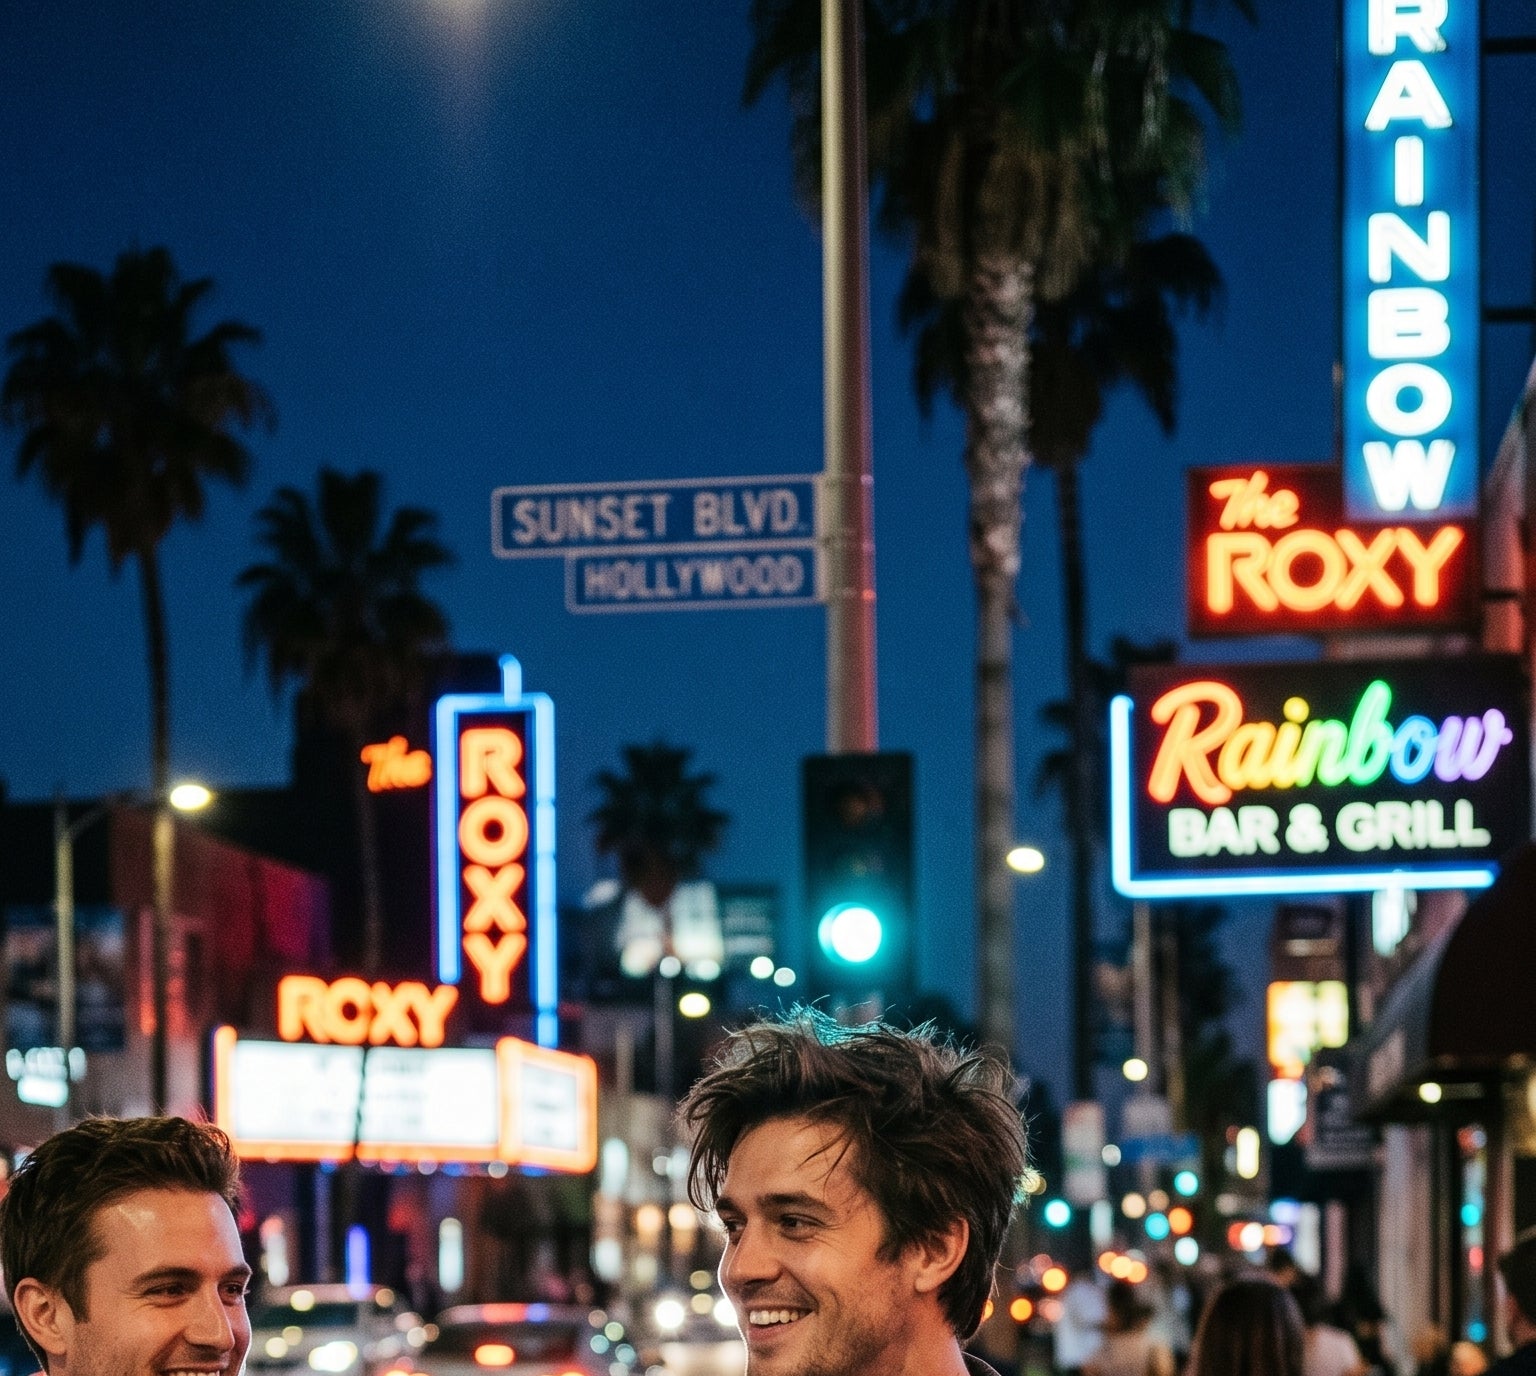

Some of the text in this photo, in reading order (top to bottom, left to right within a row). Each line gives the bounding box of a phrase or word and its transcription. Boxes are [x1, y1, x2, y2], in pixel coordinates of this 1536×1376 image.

[1363, 0, 1456, 512] RAINBOW
[512, 494, 670, 543] SUNSET
[1209, 470, 1300, 531] The
[1207, 526, 1463, 614] ROXY
[1147, 680, 1514, 806] Rainbow
[458, 727, 530, 1004] ROXY
[1167, 797, 1492, 858] BAR & GRILL
[277, 974, 458, 1049] ROXY
